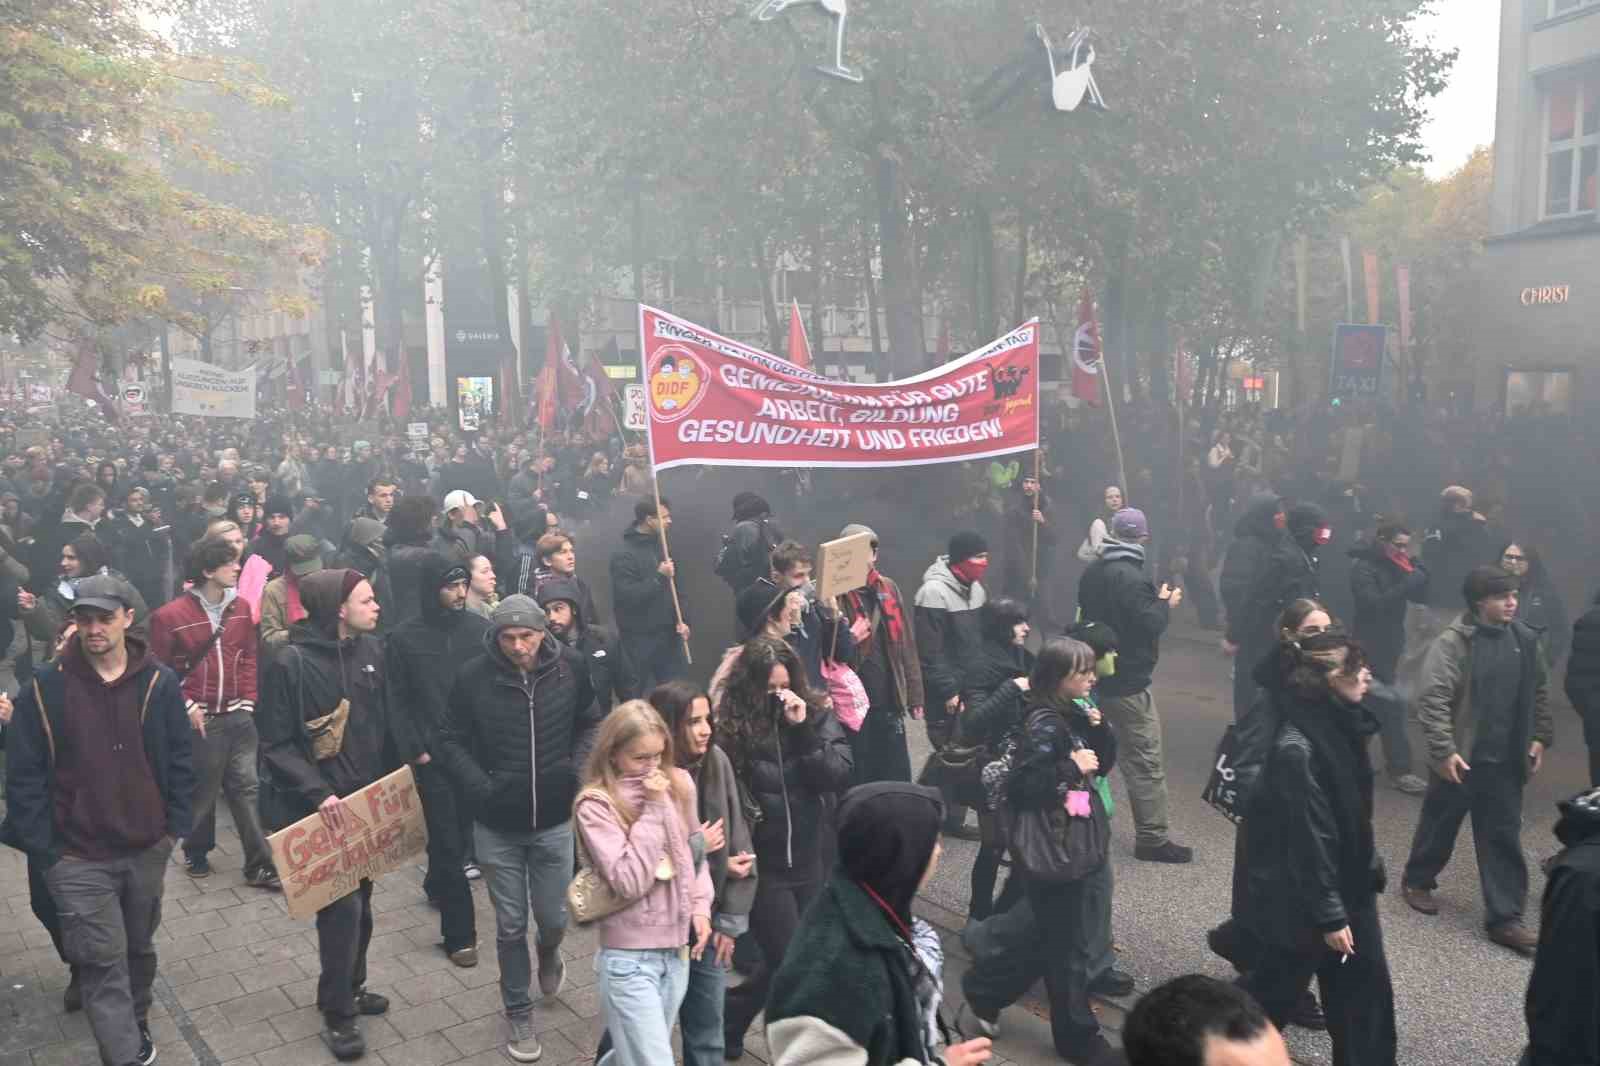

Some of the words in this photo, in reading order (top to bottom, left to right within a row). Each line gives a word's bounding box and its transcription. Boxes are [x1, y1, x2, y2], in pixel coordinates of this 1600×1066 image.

[1521, 285, 1569, 305] CHRIST
[657, 382, 689, 396] DIDF
[930, 369, 988, 400] GUTE
[1336, 375, 1377, 393] TAXI
[755, 397, 845, 427] ARBEIT,
[678, 418, 852, 449] GESUNDHEIT
[856, 428, 906, 450] UND
[909, 417, 1004, 448] FRIEDEN!
